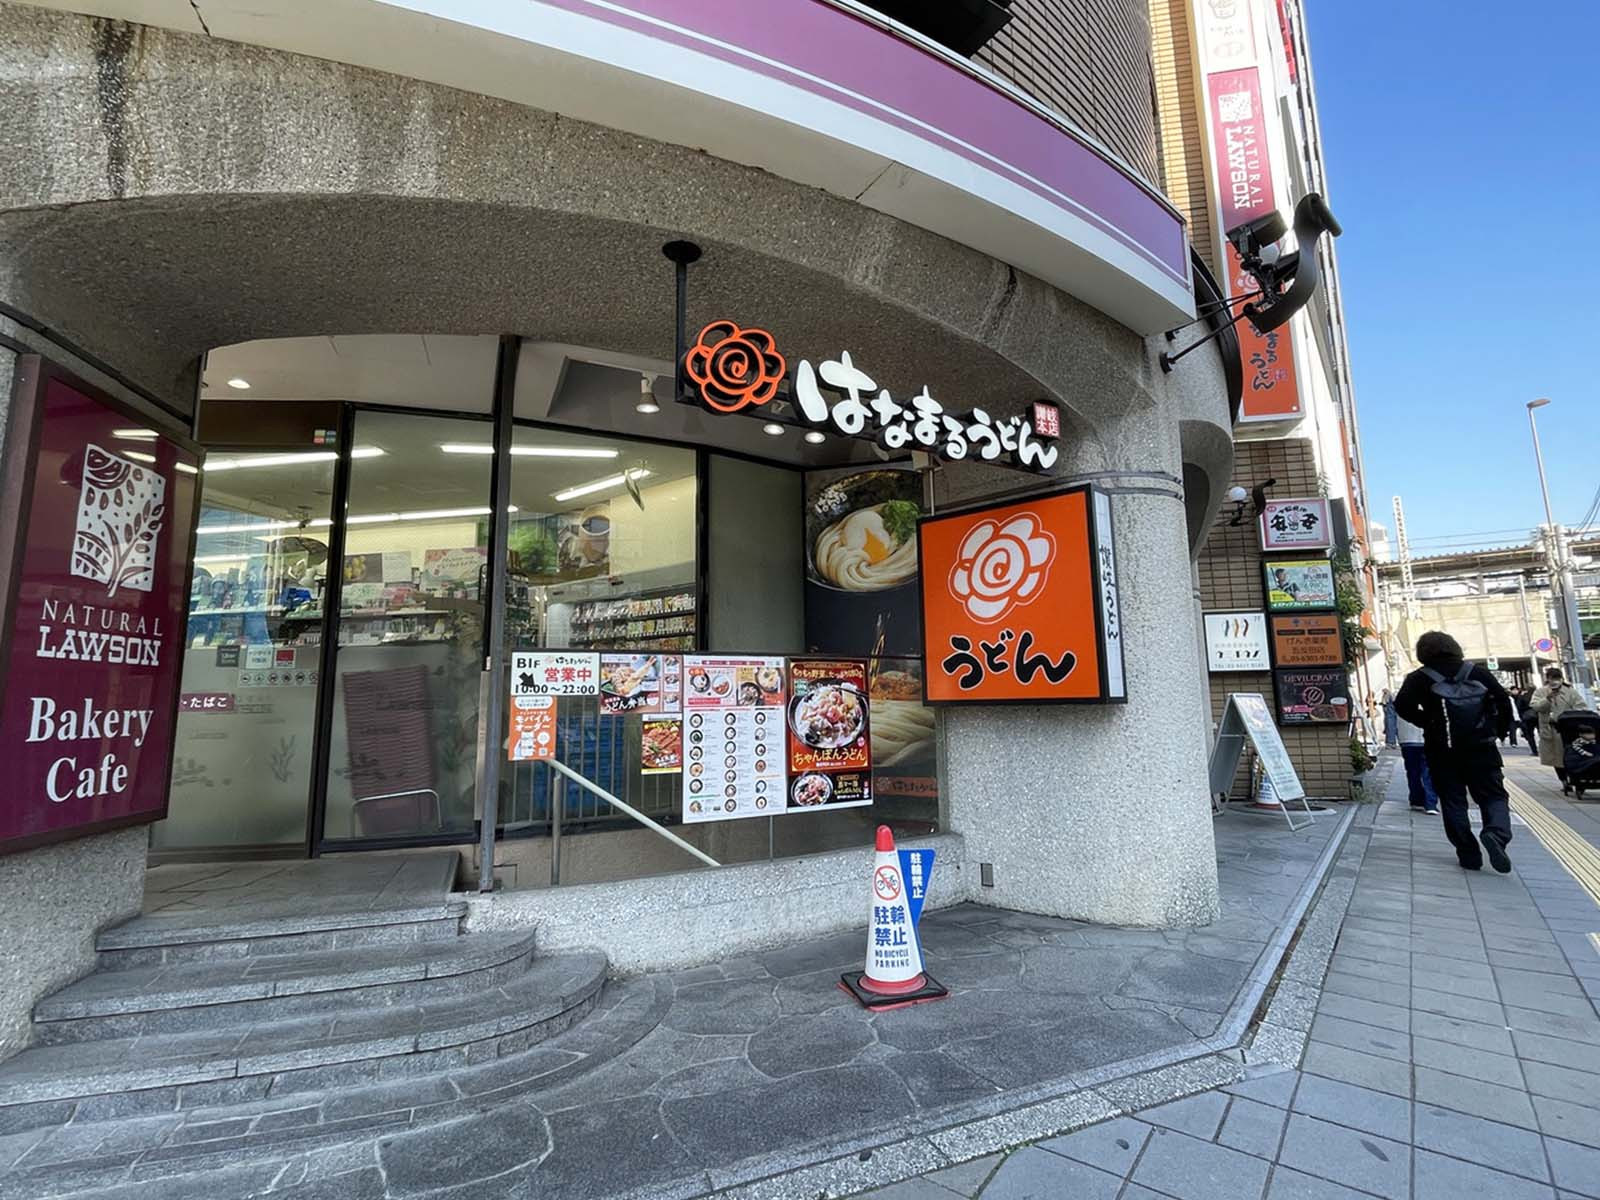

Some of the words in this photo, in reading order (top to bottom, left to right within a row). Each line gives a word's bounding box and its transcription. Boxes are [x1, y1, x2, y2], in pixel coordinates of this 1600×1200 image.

[1225, 126, 1251, 209] LAWSON
[1242, 126, 1264, 207] NATURAL
[796, 350, 1058, 470] はなまるうどん
[42, 599, 164, 637] NATURAL
[36, 625, 162, 667] LAWSON
[942, 628, 1077, 690] うどん
[544, 667, 592, 683] 営業中
[26, 696, 154, 748] Bakery
[515, 715, 552, 724] モバイル
[46, 755, 129, 803] Cafe
[910, 852, 924, 899] 駐輪禁止
[874, 906, 905, 926] 駐輪
[874, 926, 907, 947] 禁止
[875, 949, 883, 958] NO
[884, 948, 909, 958] BICYCLE
[875, 958, 910, 968] PARKING
